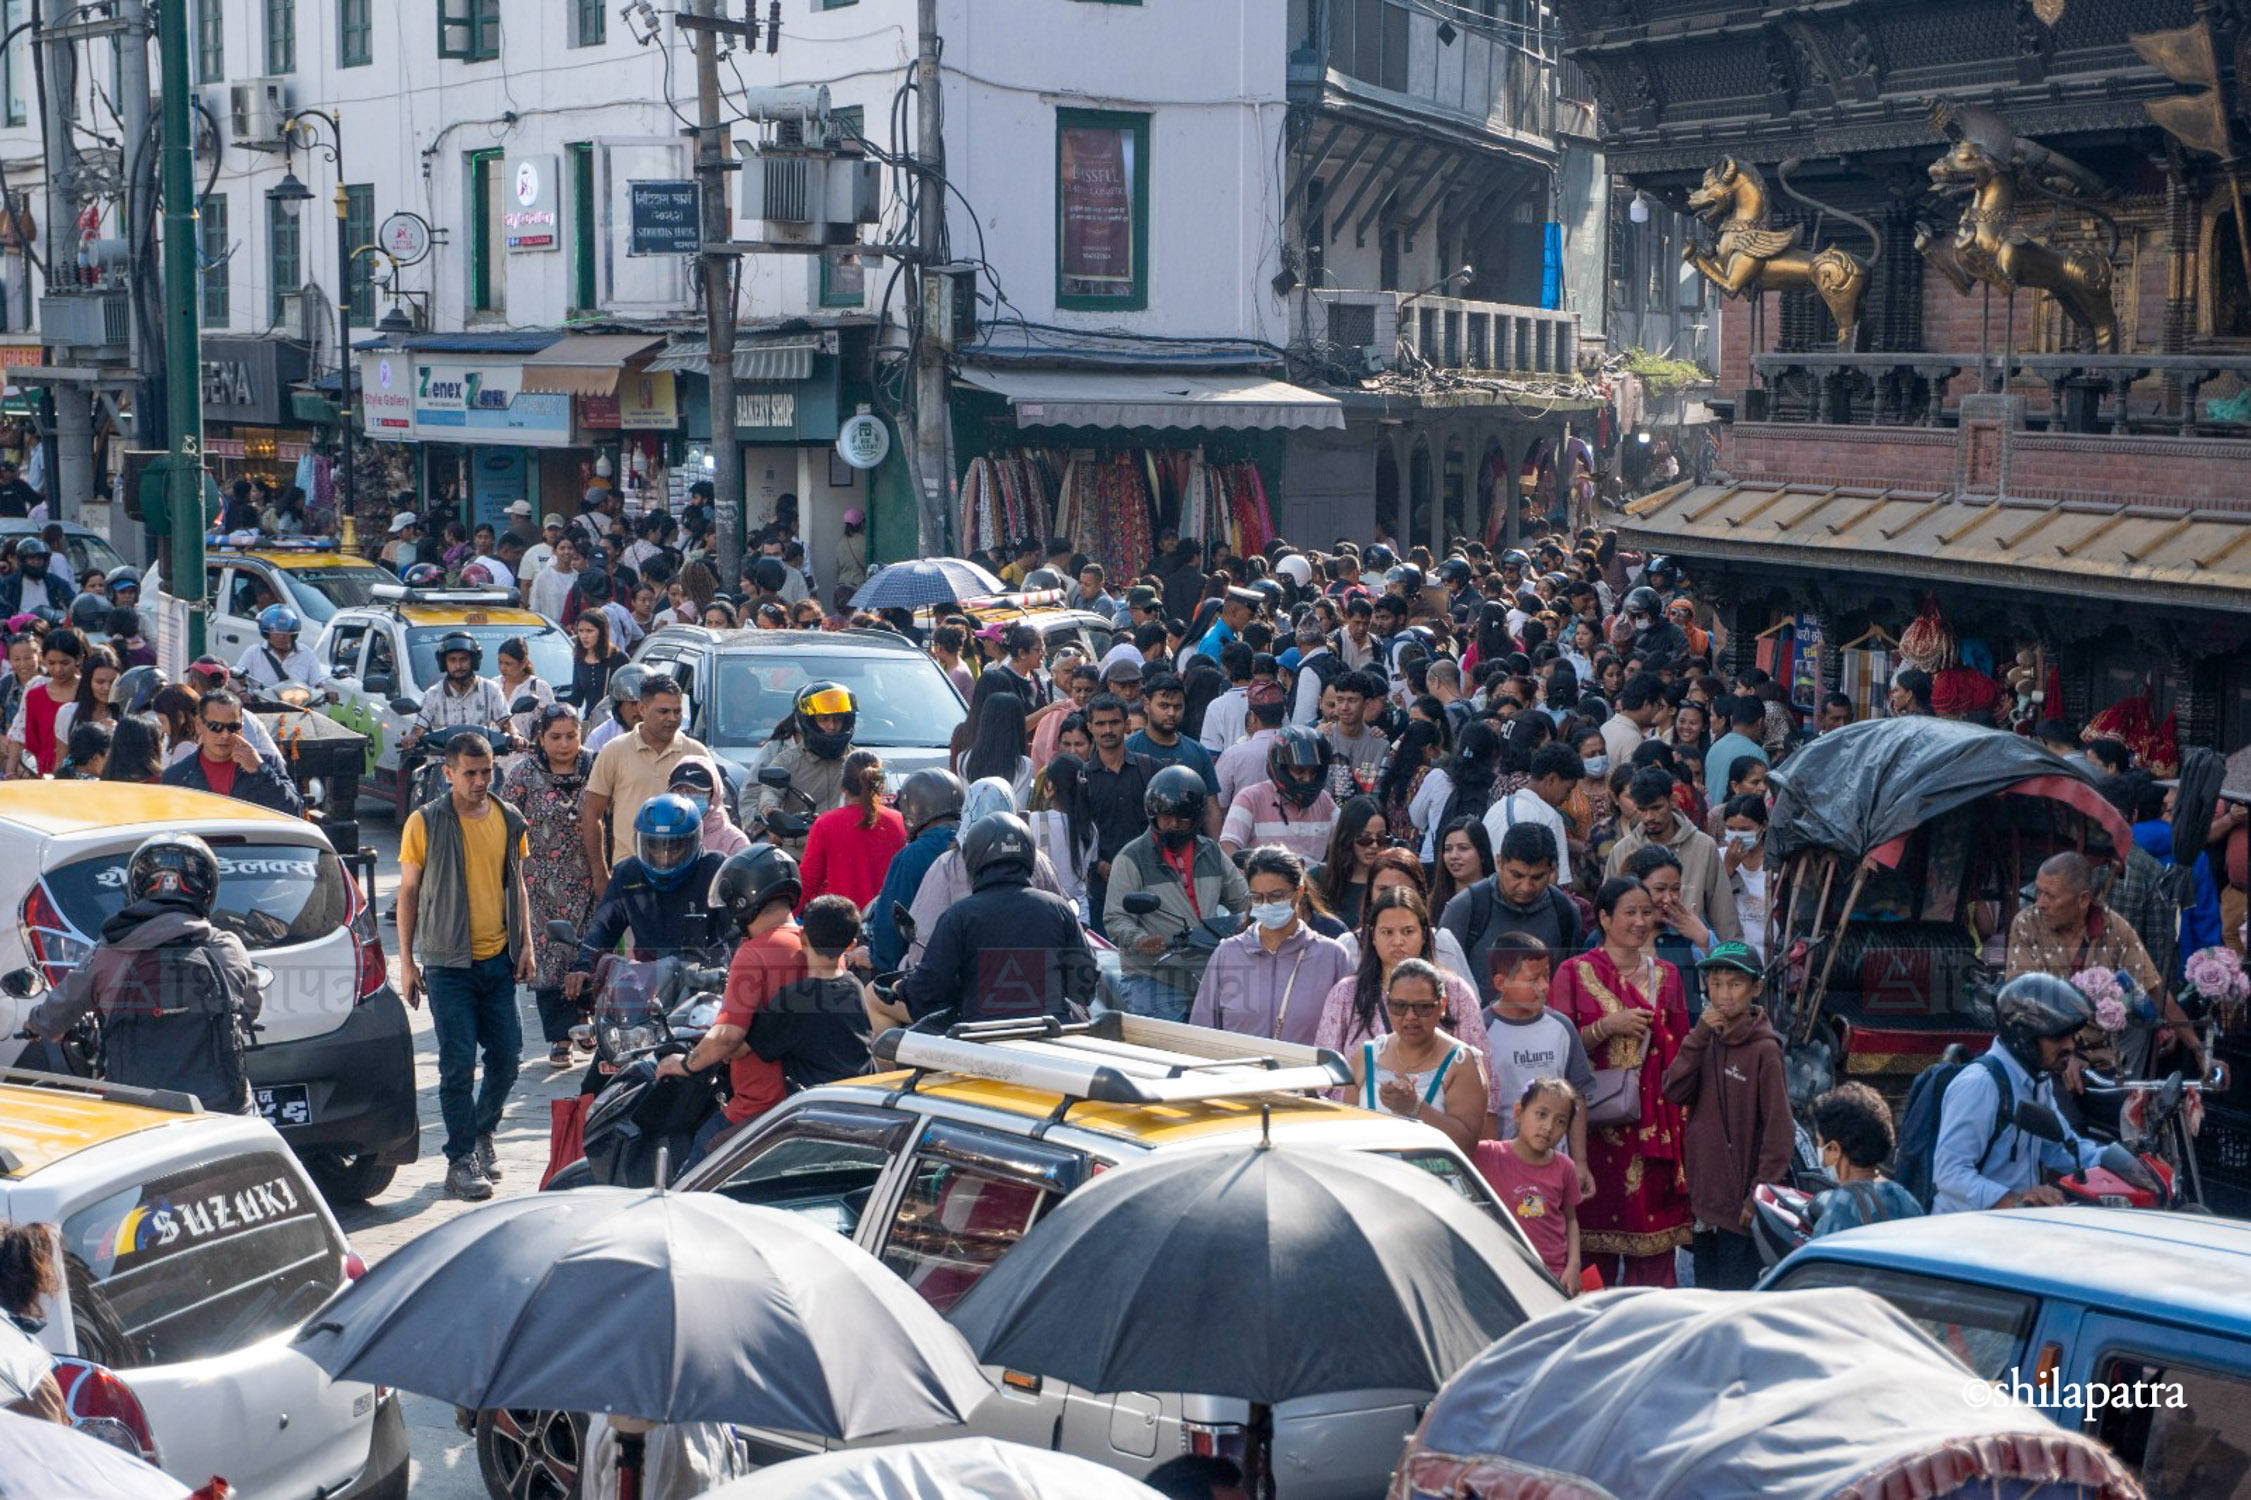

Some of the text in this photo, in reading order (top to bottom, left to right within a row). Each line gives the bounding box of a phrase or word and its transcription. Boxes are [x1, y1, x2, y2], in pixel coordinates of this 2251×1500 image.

[418, 367, 462, 398] Zenex
[736, 393, 795, 427] BAKERY SHOP
[152, 1176, 298, 1246] SUZUKI
